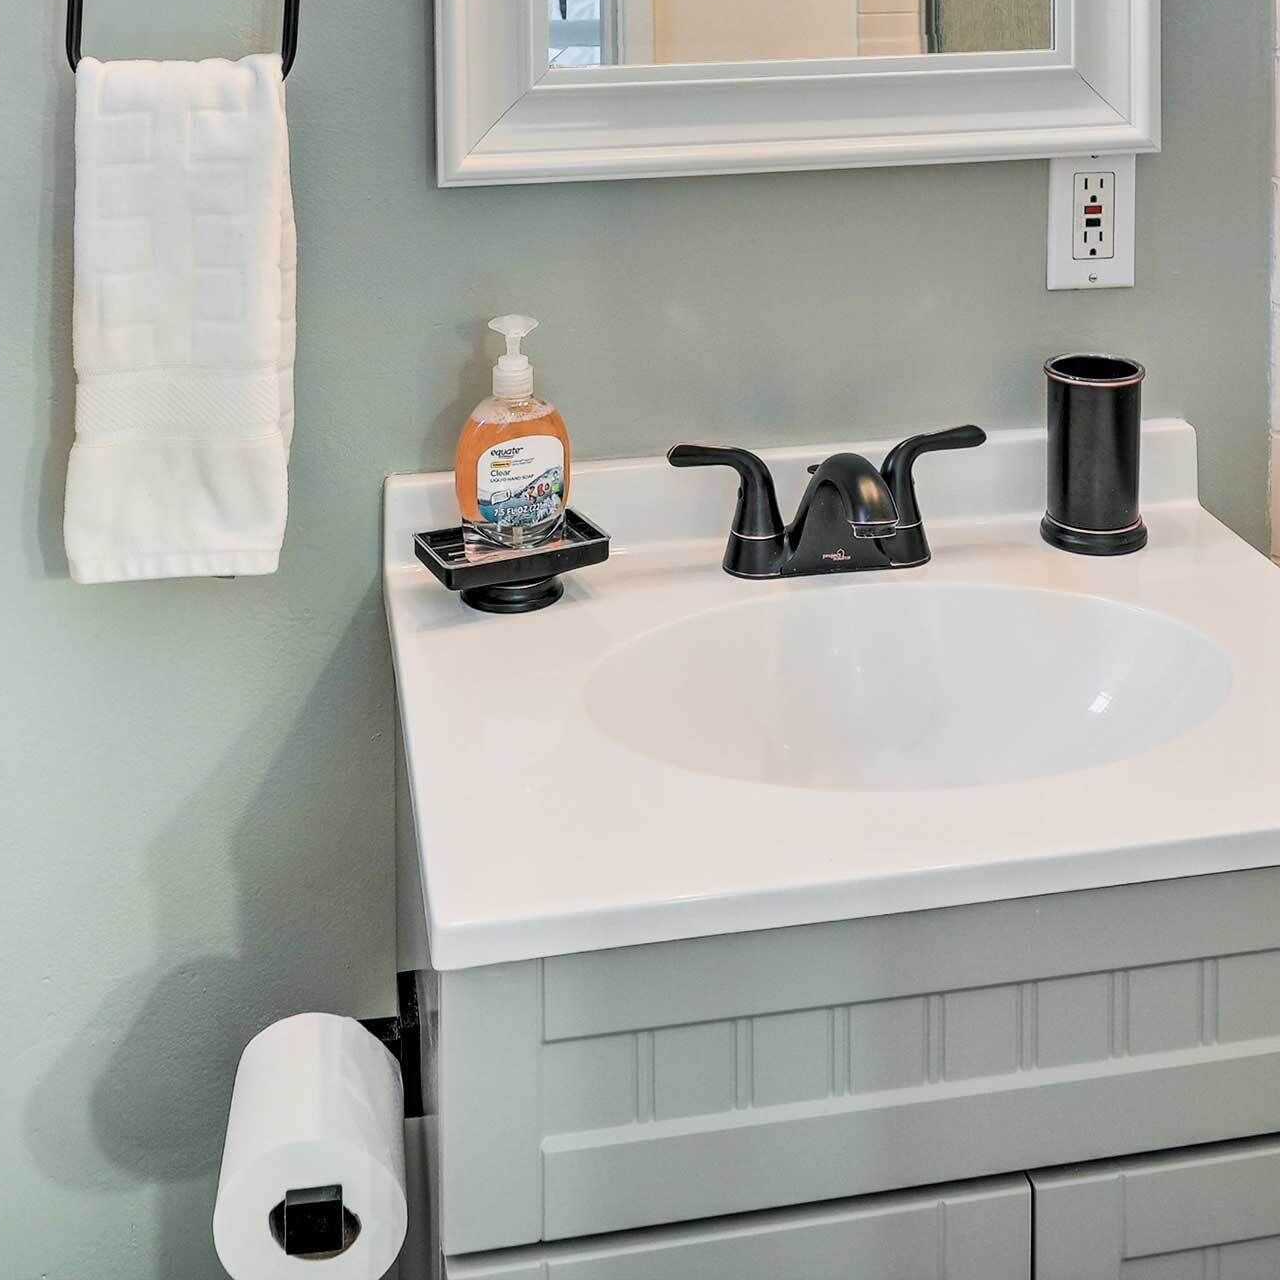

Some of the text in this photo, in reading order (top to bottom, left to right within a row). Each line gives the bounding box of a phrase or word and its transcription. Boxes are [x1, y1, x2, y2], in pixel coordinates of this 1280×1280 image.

[490, 447, 520, 457] equate
[490, 469, 511, 477] Clear
[506, 507, 516, 515] FL
